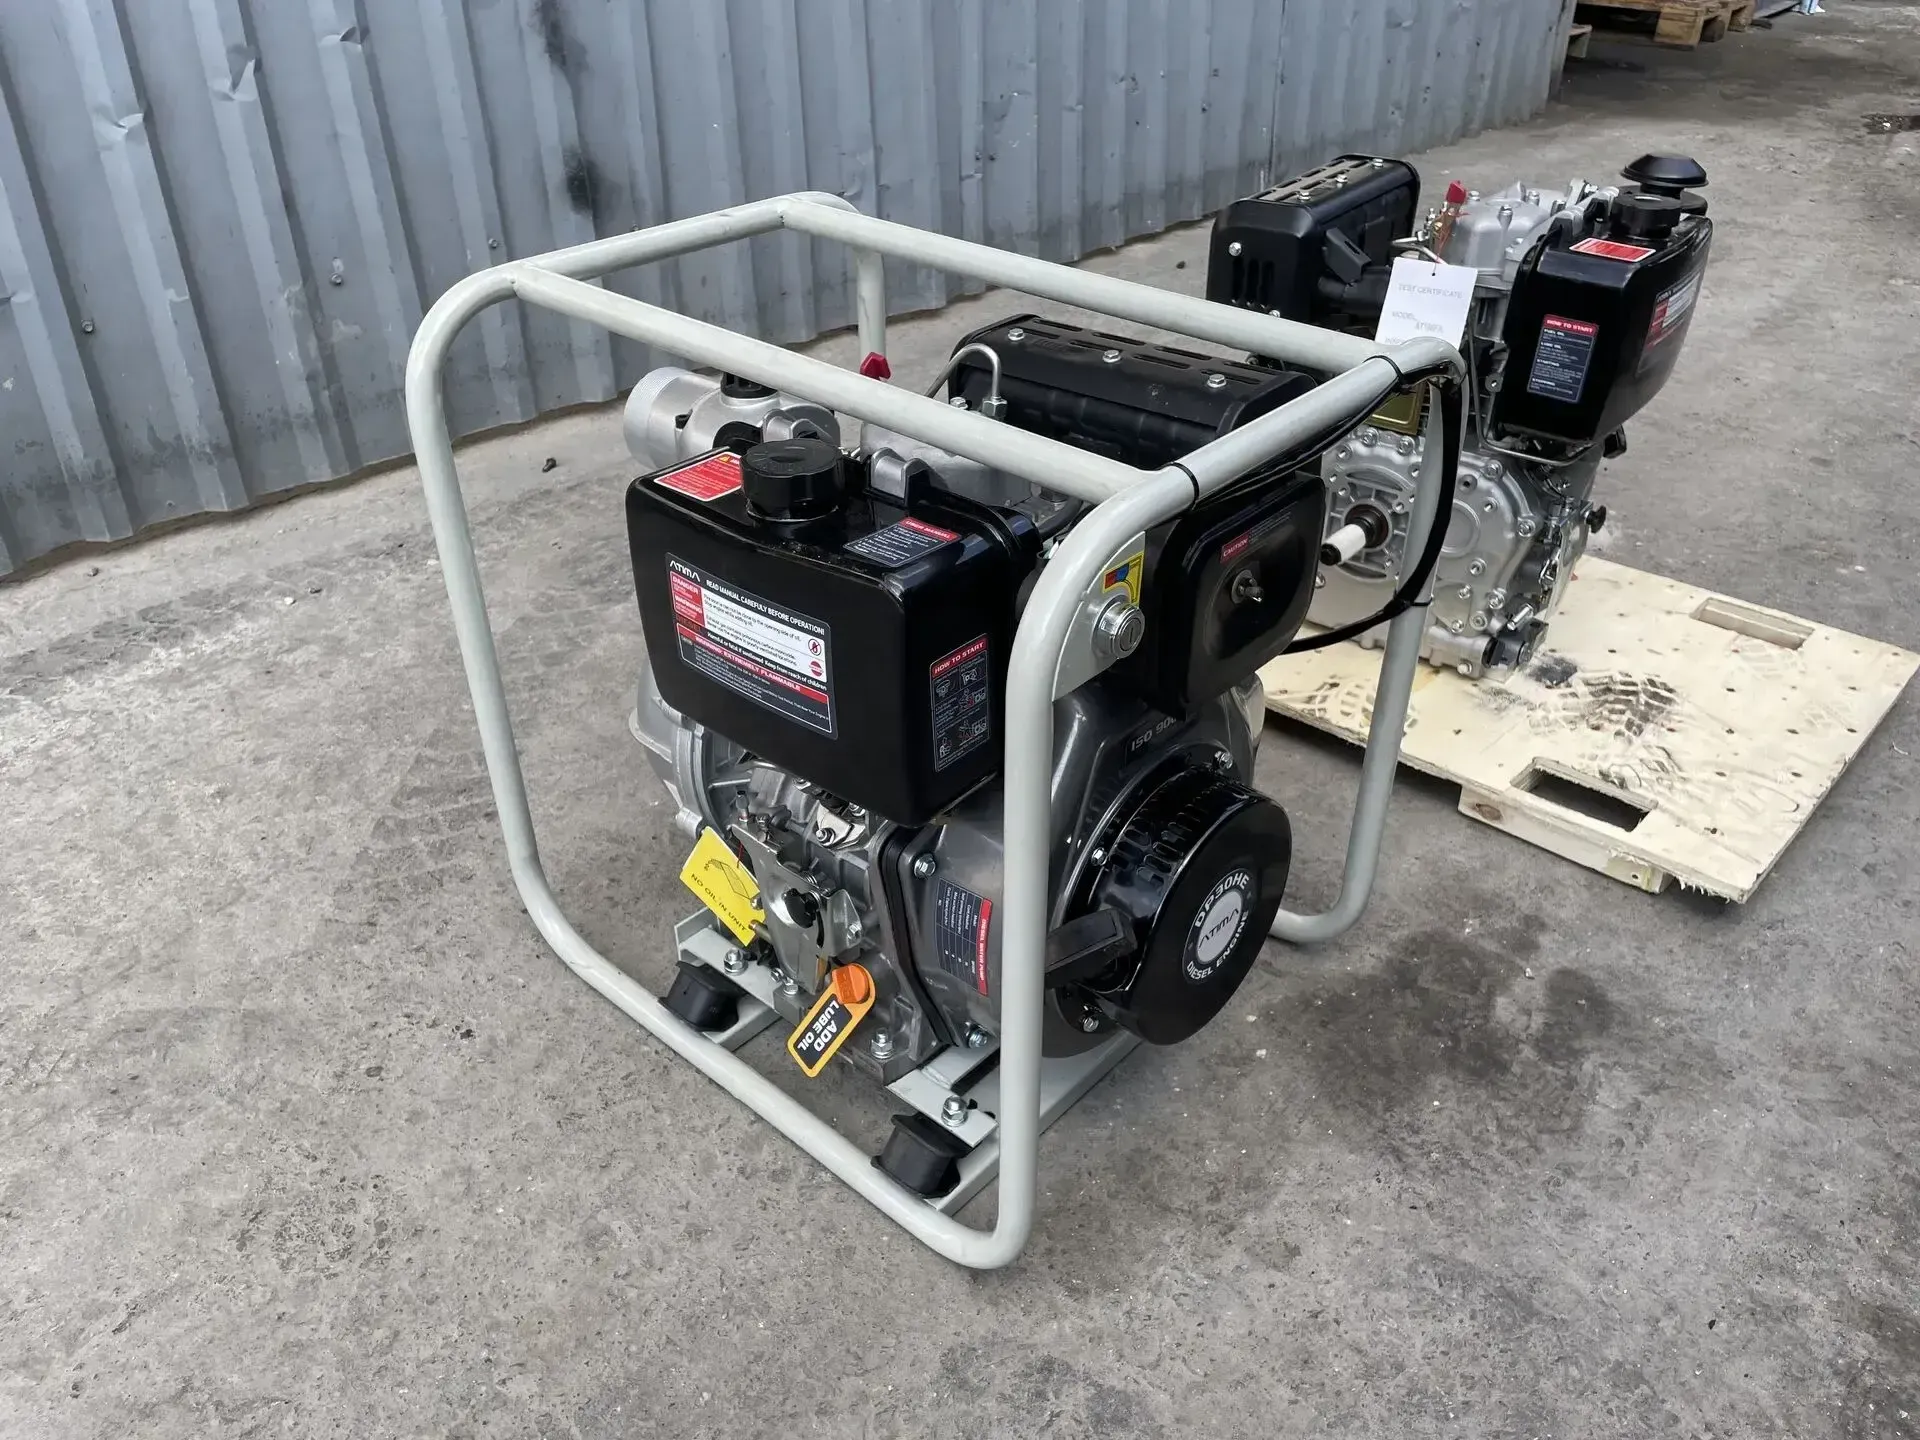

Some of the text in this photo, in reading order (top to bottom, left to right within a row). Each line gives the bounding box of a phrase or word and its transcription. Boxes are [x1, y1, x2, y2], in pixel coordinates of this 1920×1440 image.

[1572, 324, 1593, 333] START
[923, 527, 951, 539] MANUAL
[1223, 538, 1248, 557] CAUTION
[672, 576, 699, 595] DANGER
[706, 579, 719, 591] READ
[719, 586, 741, 601] MANUAL
[767, 607, 790, 622] BEFORE
[674, 595, 702, 614] WARNING
[723, 650, 761, 673] EXTREMELY
[760, 669, 801, 692] FLAMMABLE
[934, 660, 951, 674] HOW
[951, 655, 961, 664] TO
[962, 641, 984, 658] START
[807, 677, 826, 692] children
[1131, 729, 1153, 751] ISO
[691, 873, 747, 932] NO OIL IN UNIT
[1194, 872, 1250, 928] DP30HE
[979, 918, 988, 941] DIESEL
[1198, 908, 1239, 949] ATIMA
[1186, 910, 1249, 980] DIESEL ENGINE
[797, 1000, 840, 1051] LUBE OIL
[813, 1020, 838, 1052] ADD
